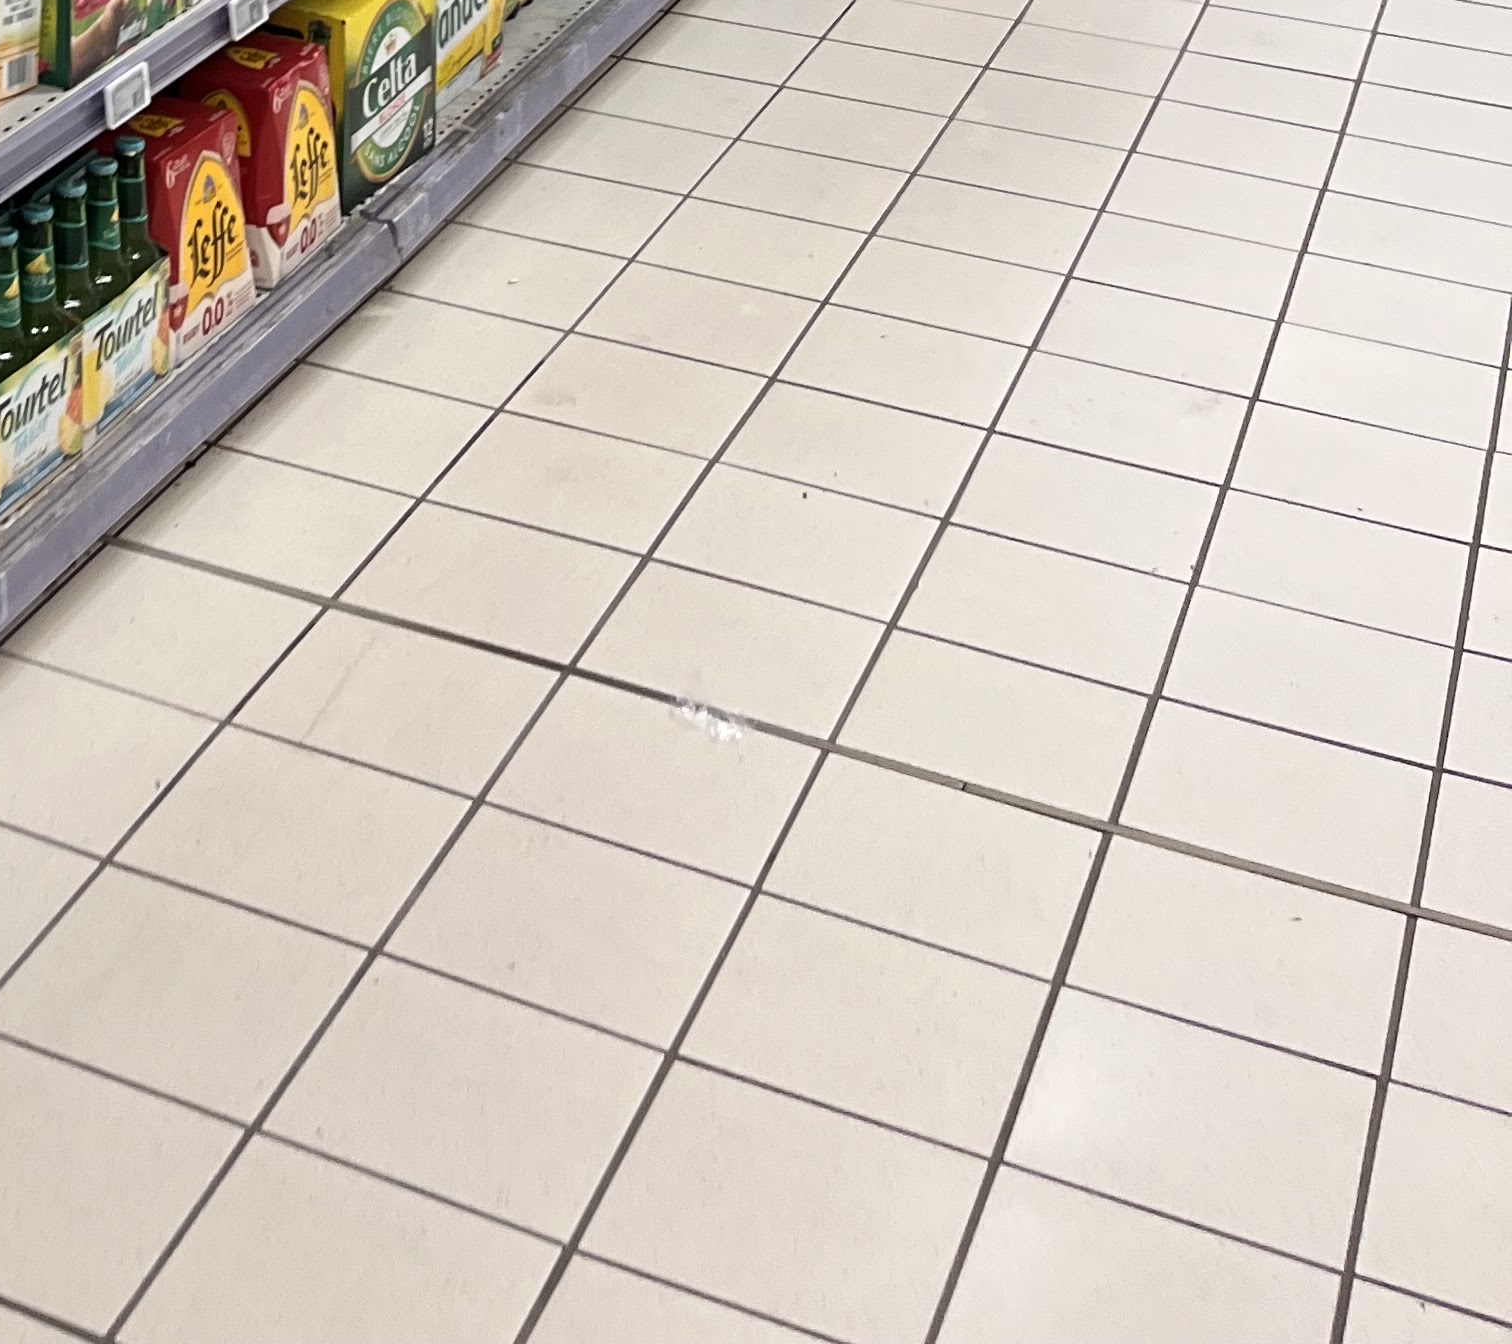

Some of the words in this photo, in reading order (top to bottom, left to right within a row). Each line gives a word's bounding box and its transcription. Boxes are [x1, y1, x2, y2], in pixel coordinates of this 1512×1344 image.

[362, 47, 419, 119] Celta
[290, 126, 330, 209] Leffe
[187, 199, 238, 287] Leffe
[92, 280, 161, 373] Tourtel
